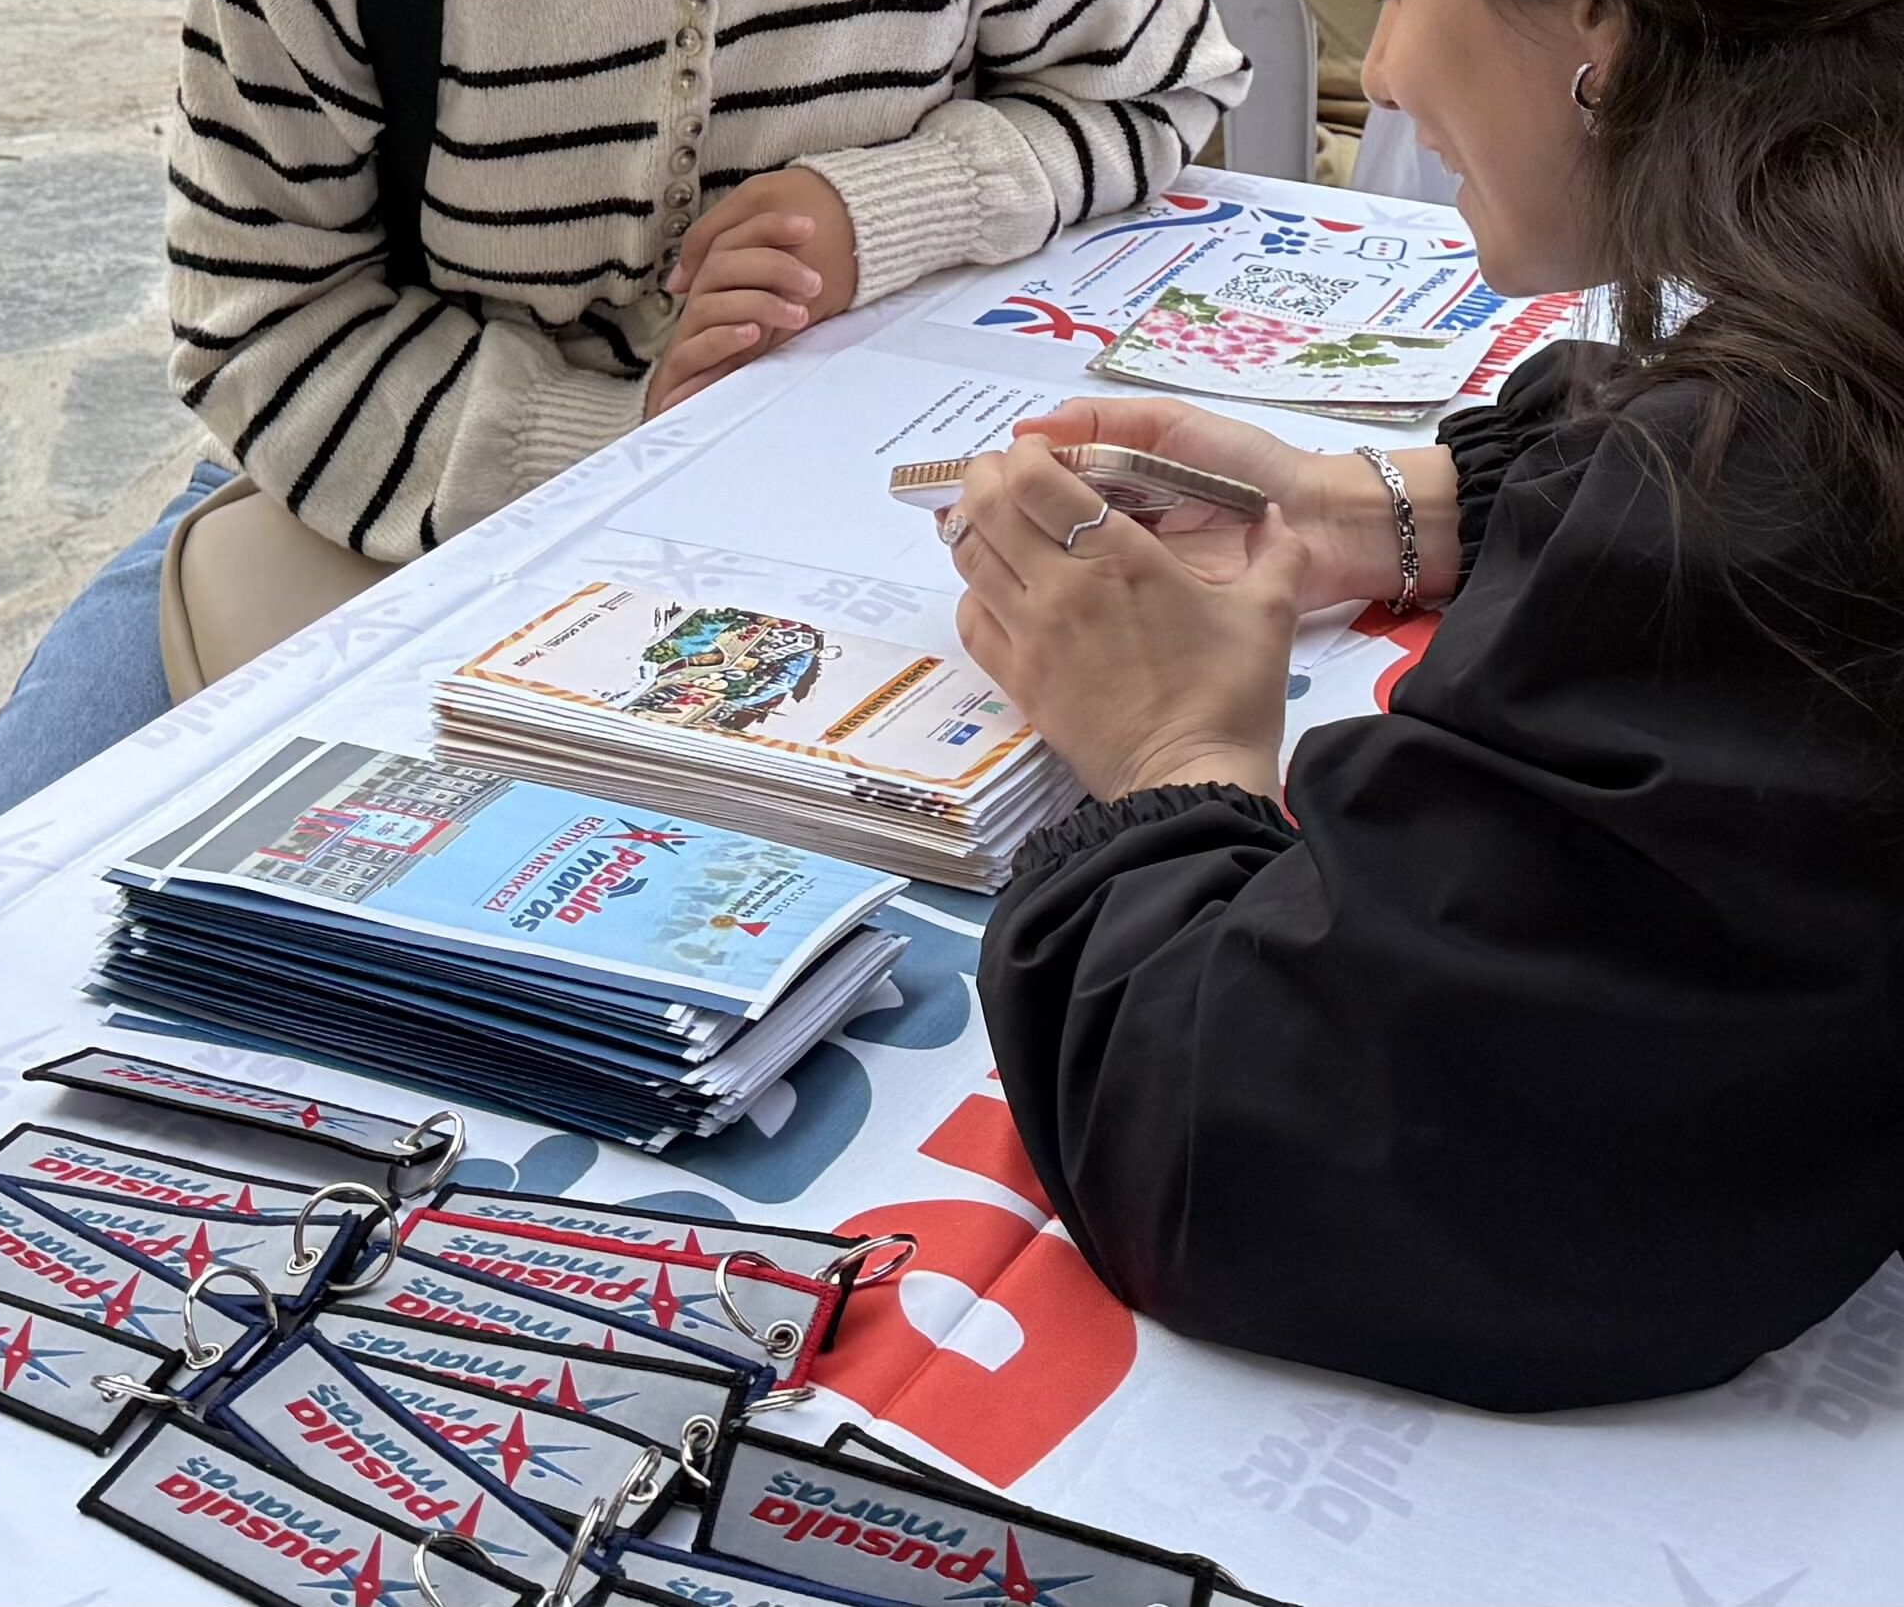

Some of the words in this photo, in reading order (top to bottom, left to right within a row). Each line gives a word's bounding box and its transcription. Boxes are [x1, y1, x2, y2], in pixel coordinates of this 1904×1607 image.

[555, 815, 605, 851] EĞİTİM
[483, 851, 558, 914] MERKEZİ
[510, 849, 611, 933] maraş
[555, 845, 647, 925] pusula
[28, 1157, 233, 1210] pusula
[49, 1145, 211, 1194] maraş
[443, 1235, 626, 1280] maraş
[470, 1205, 654, 1242] maraş
[403, 1276, 573, 1342] maraş
[339, 1329, 529, 1381] maraş
[284, 1396, 461, 1522] pusula
[307, 1383, 448, 1494] maraş
[1299, 1403, 1440, 1544] sula
[154, 1472, 361, 1576] pusula
[177, 1455, 342, 1544] maraş
[763, 1470, 969, 1548] maraş
[749, 1495, 998, 1584] pusula
